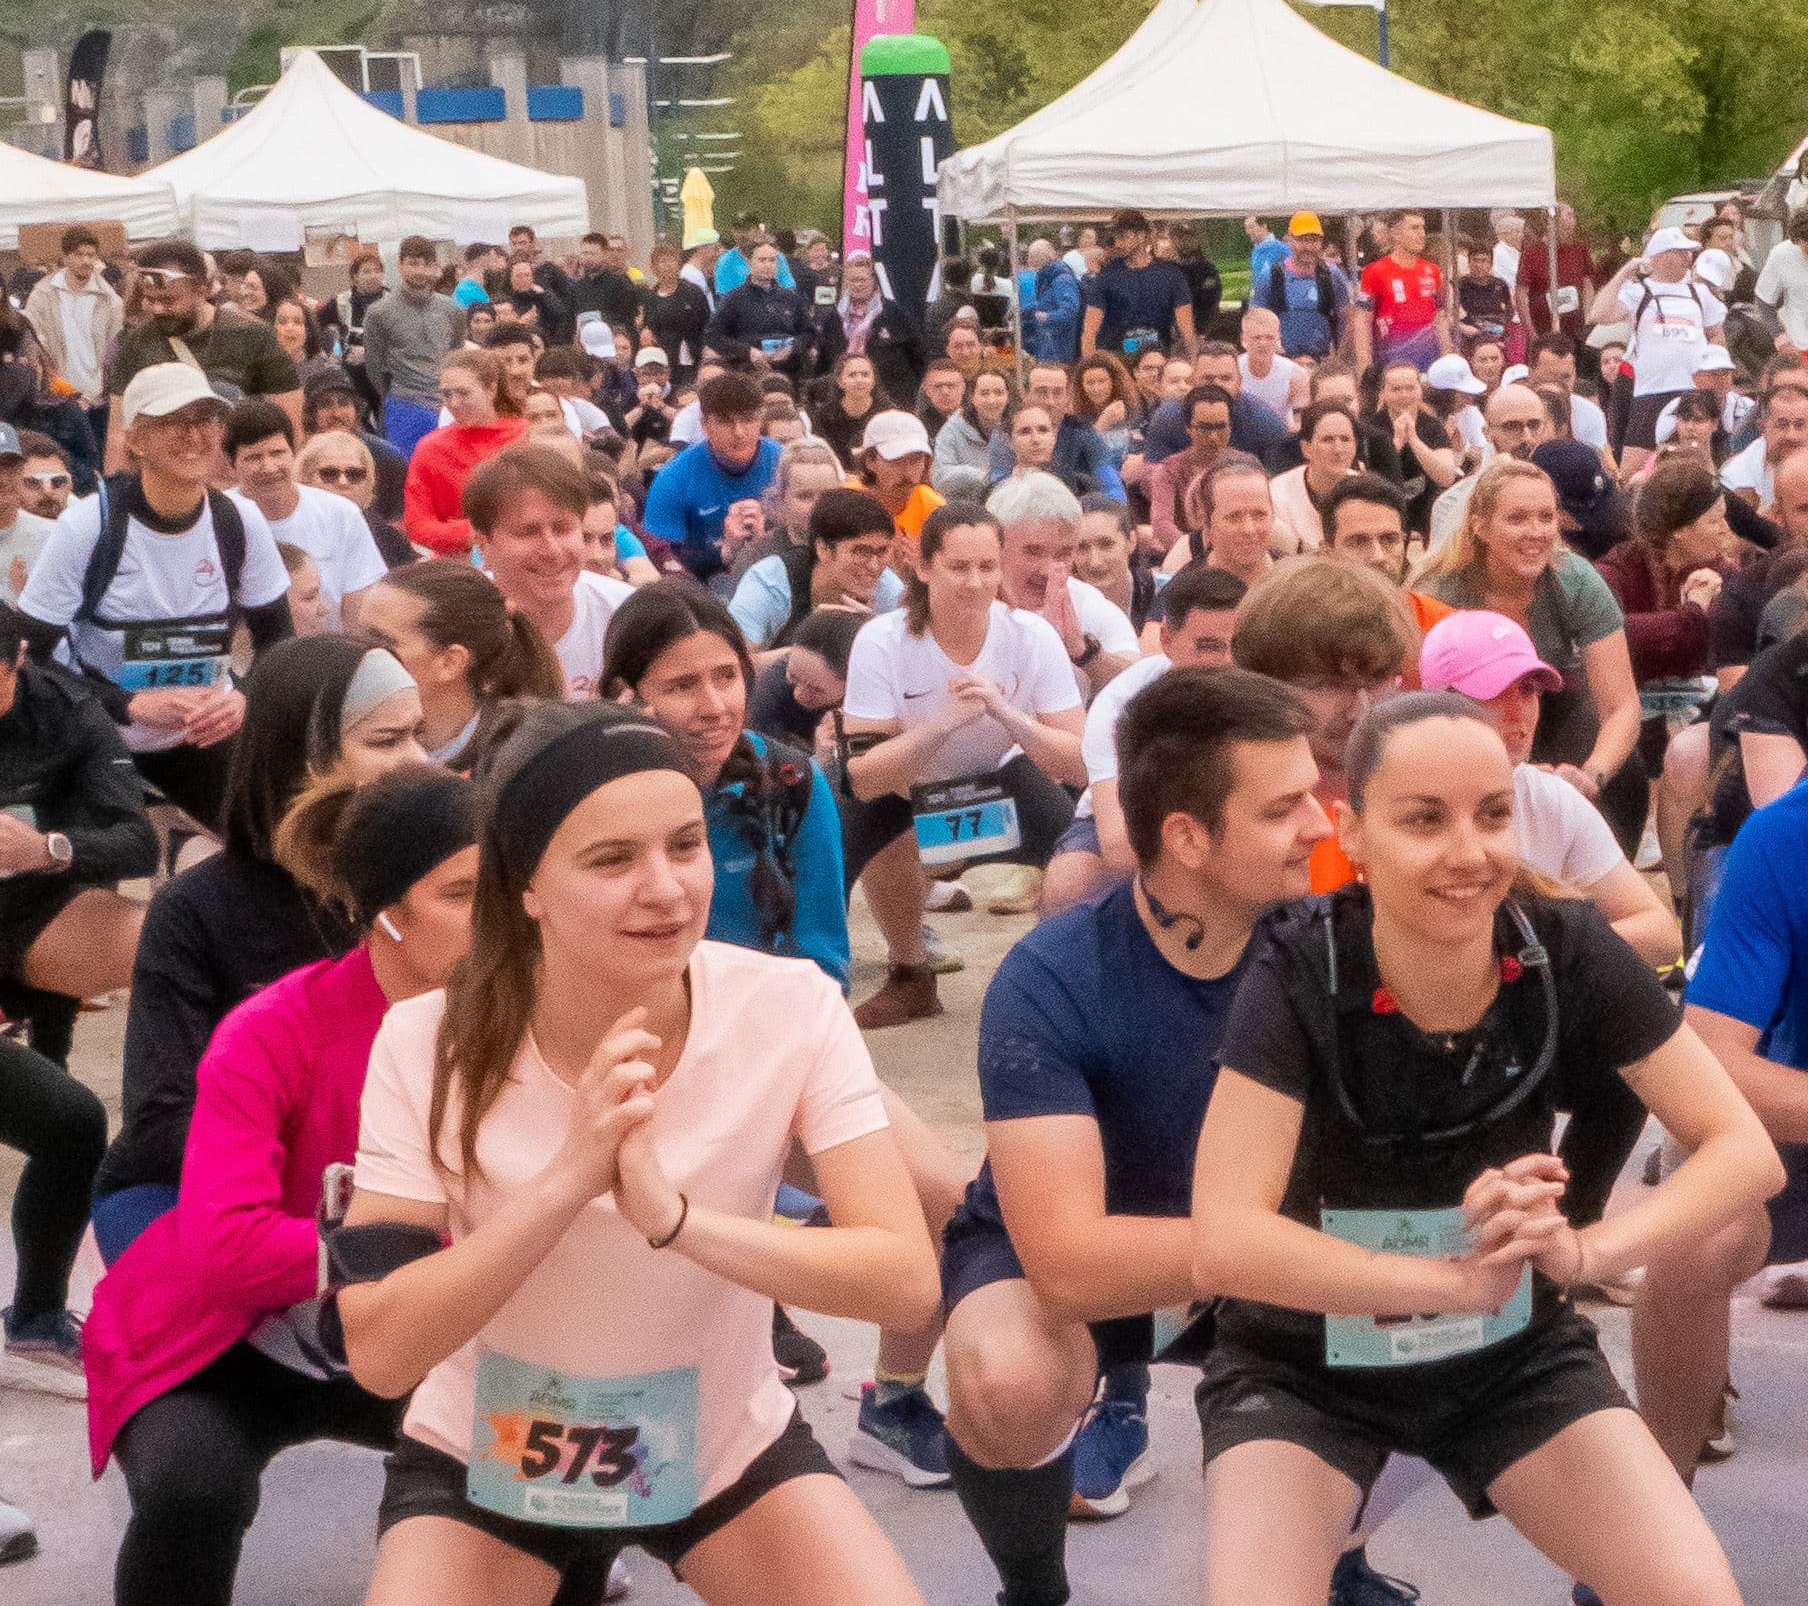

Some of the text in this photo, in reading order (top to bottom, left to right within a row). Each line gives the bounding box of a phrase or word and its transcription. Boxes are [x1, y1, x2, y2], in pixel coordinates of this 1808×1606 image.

[149, 662, 207, 688] 125
[945, 809, 982, 841] 77
[522, 1421, 640, 1487] 573
